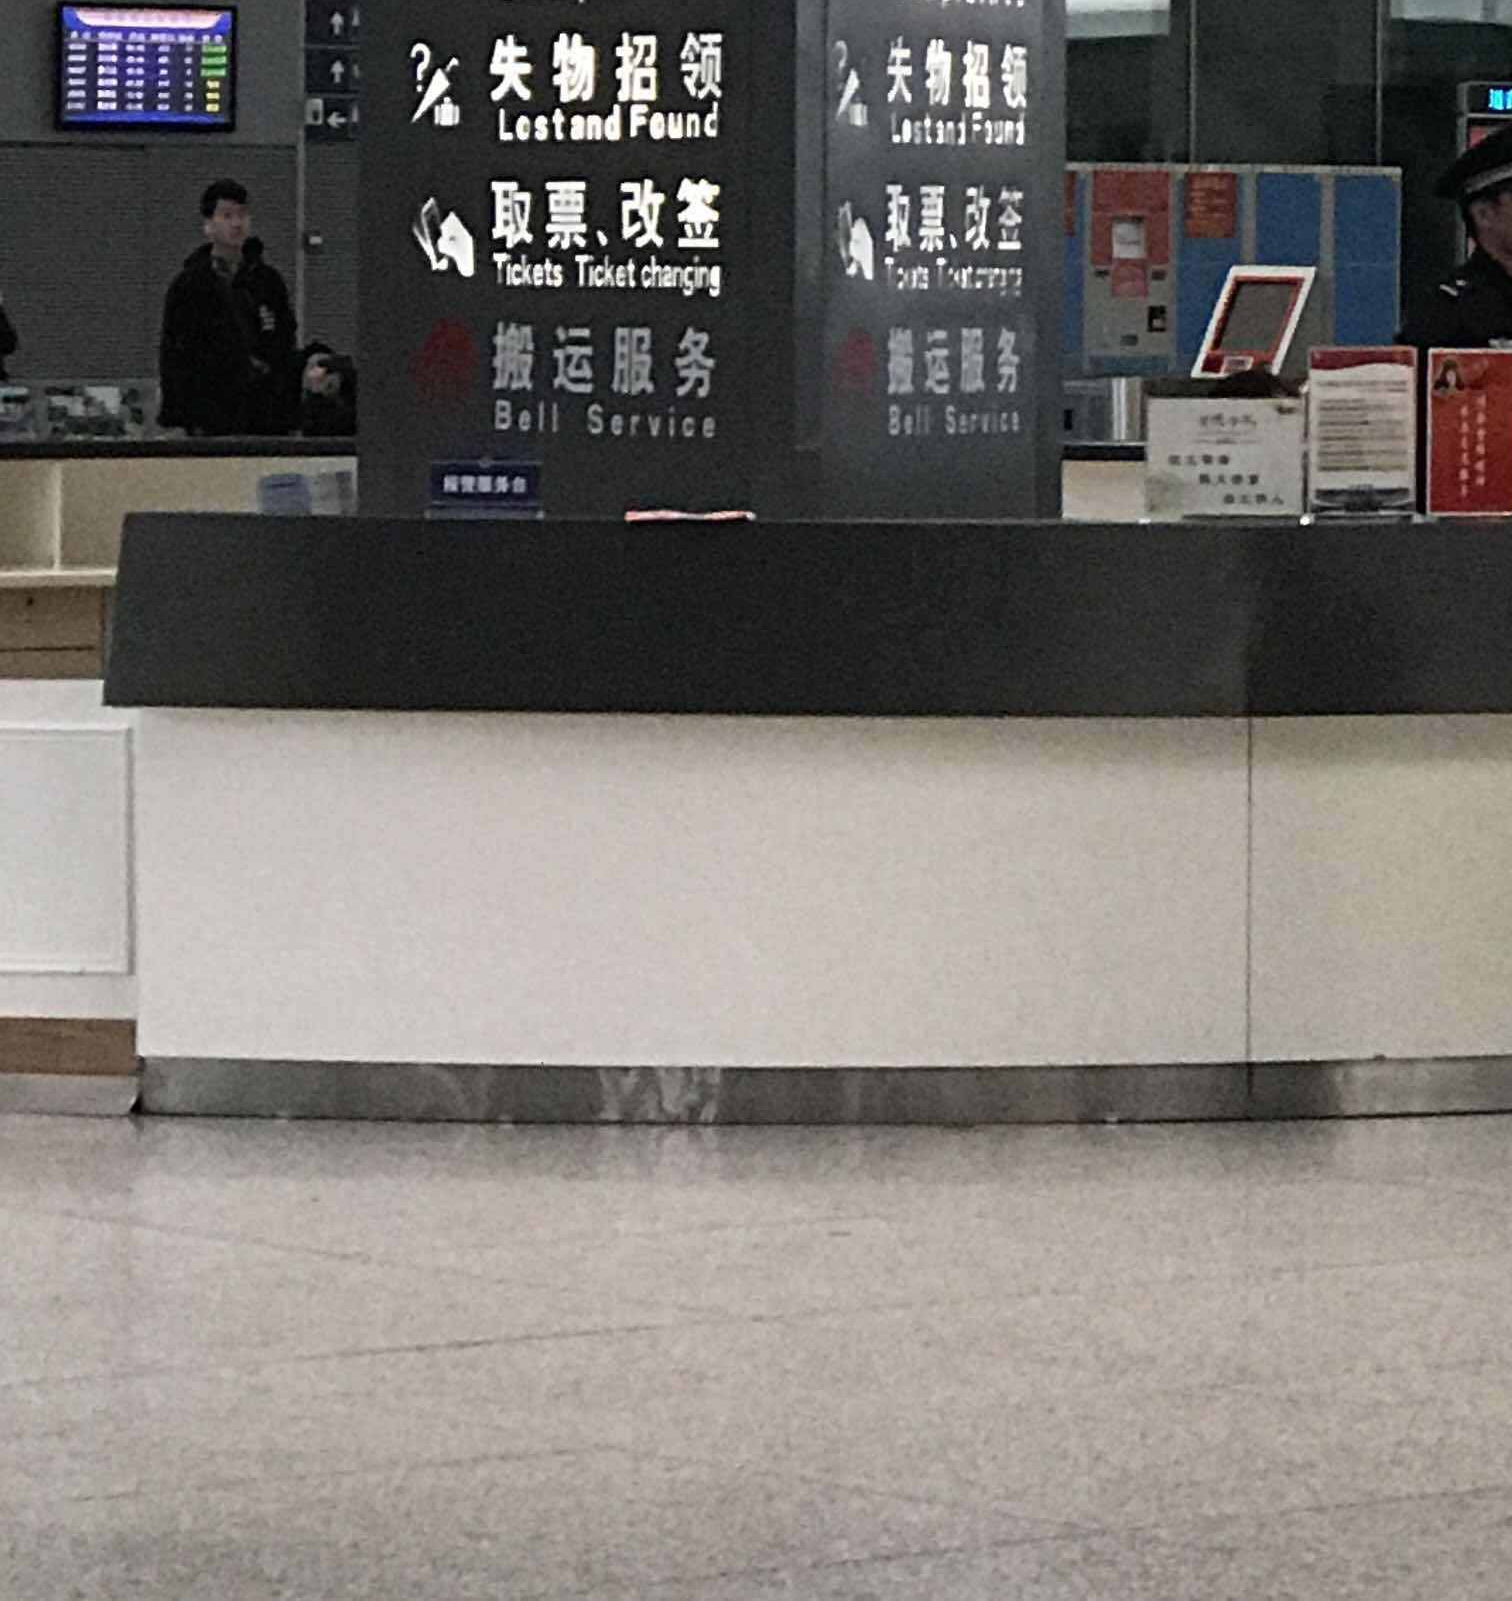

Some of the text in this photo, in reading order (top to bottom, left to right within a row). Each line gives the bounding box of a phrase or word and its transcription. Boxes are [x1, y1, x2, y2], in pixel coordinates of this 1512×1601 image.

[488, 31, 723, 104] 失物招领
[887, 35, 1027, 109] 失物招领
[630, 101, 718, 140] Found
[491, 177, 721, 249] 取票、改签
[885, 184, 1024, 253] 取票、改签
[493, 252, 721, 296] Tickets Ticket changing
[492, 321, 715, 397] 搬运服务
[887, 326, 1020, 395] 搬运服务
[495, 400, 716, 438] Bell Service
